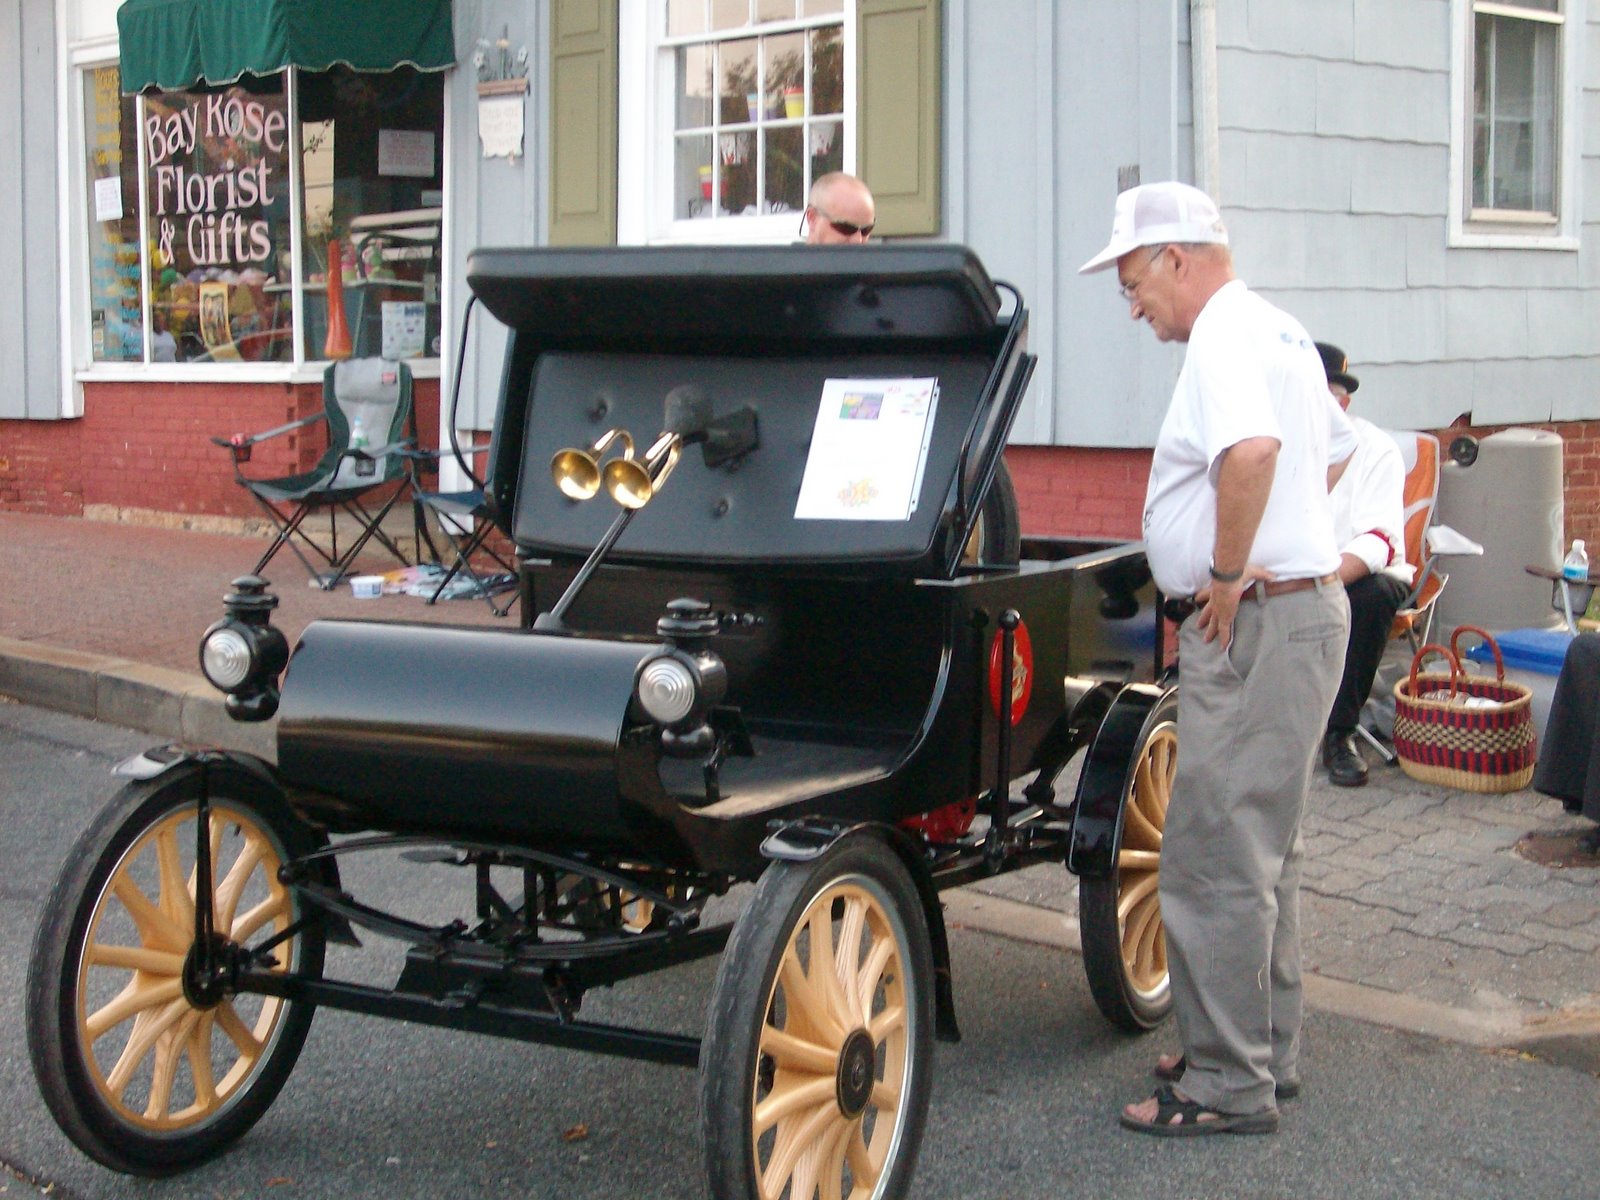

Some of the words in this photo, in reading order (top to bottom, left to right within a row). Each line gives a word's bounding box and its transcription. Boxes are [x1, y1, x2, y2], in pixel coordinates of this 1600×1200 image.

[145, 101, 199, 168] Bay
[156, 157, 274, 215] Florist
[160, 218, 175, 265] &
[187, 211, 271, 265] Gifts
